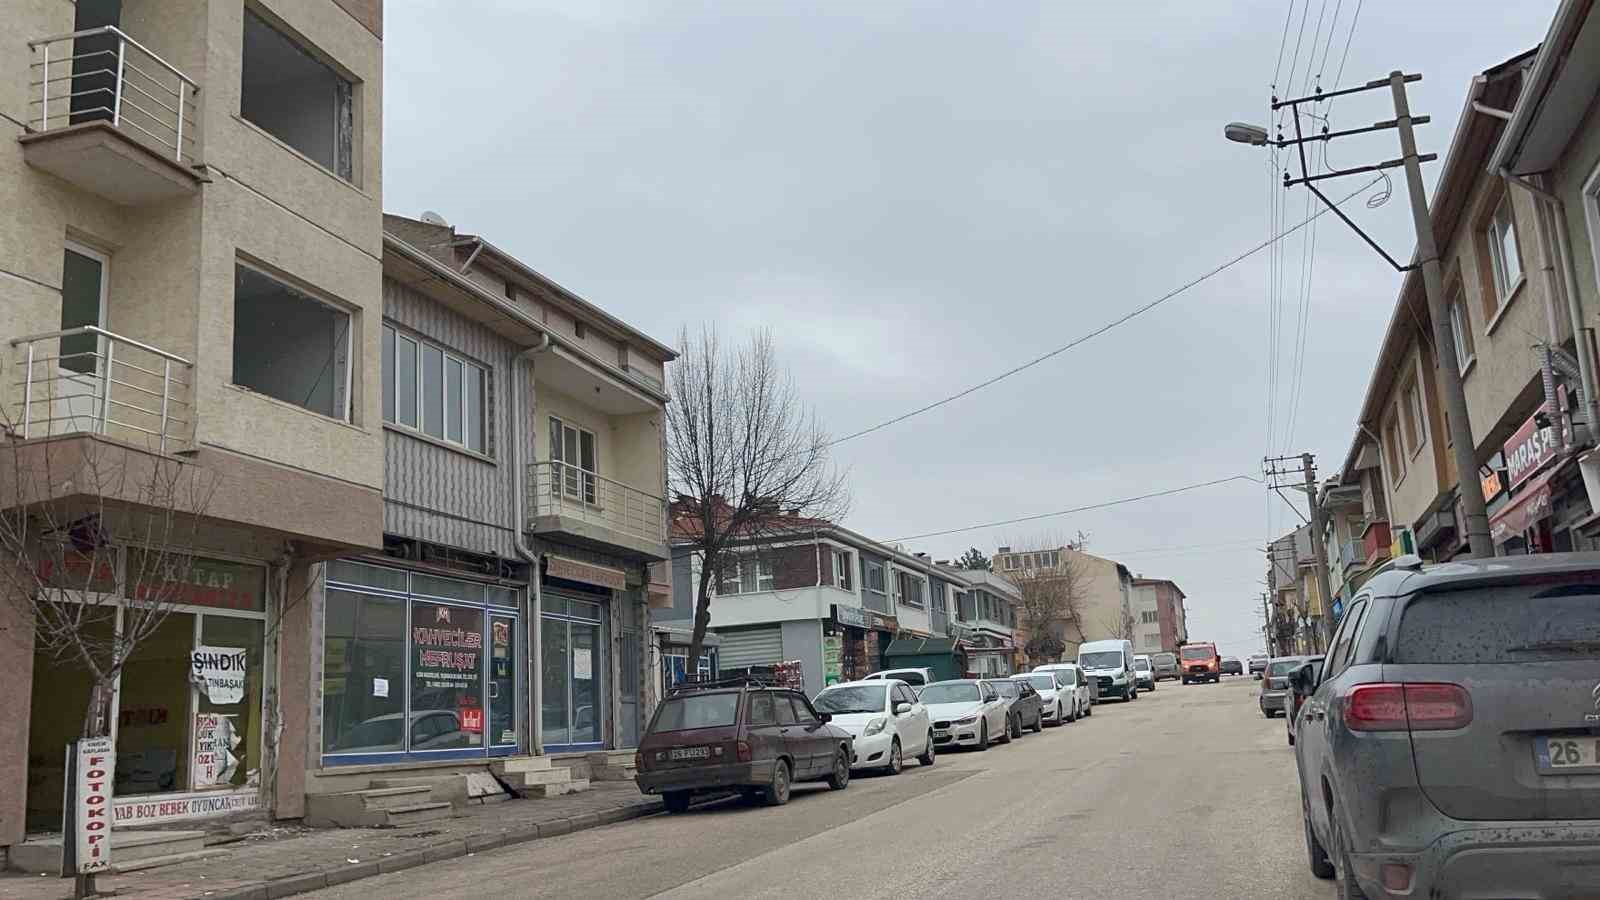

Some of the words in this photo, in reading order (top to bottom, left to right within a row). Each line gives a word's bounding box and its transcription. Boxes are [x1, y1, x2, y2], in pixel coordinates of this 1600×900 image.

[1550, 740, 1580, 765] 26
[86, 756, 106, 858] FOTOKOPİ
[135, 803, 157, 819] BOZ
[158, 800, 190, 816] BEBEK
[191, 796, 232, 813] OYUNCAK
[83, 860, 107, 871] FAX
